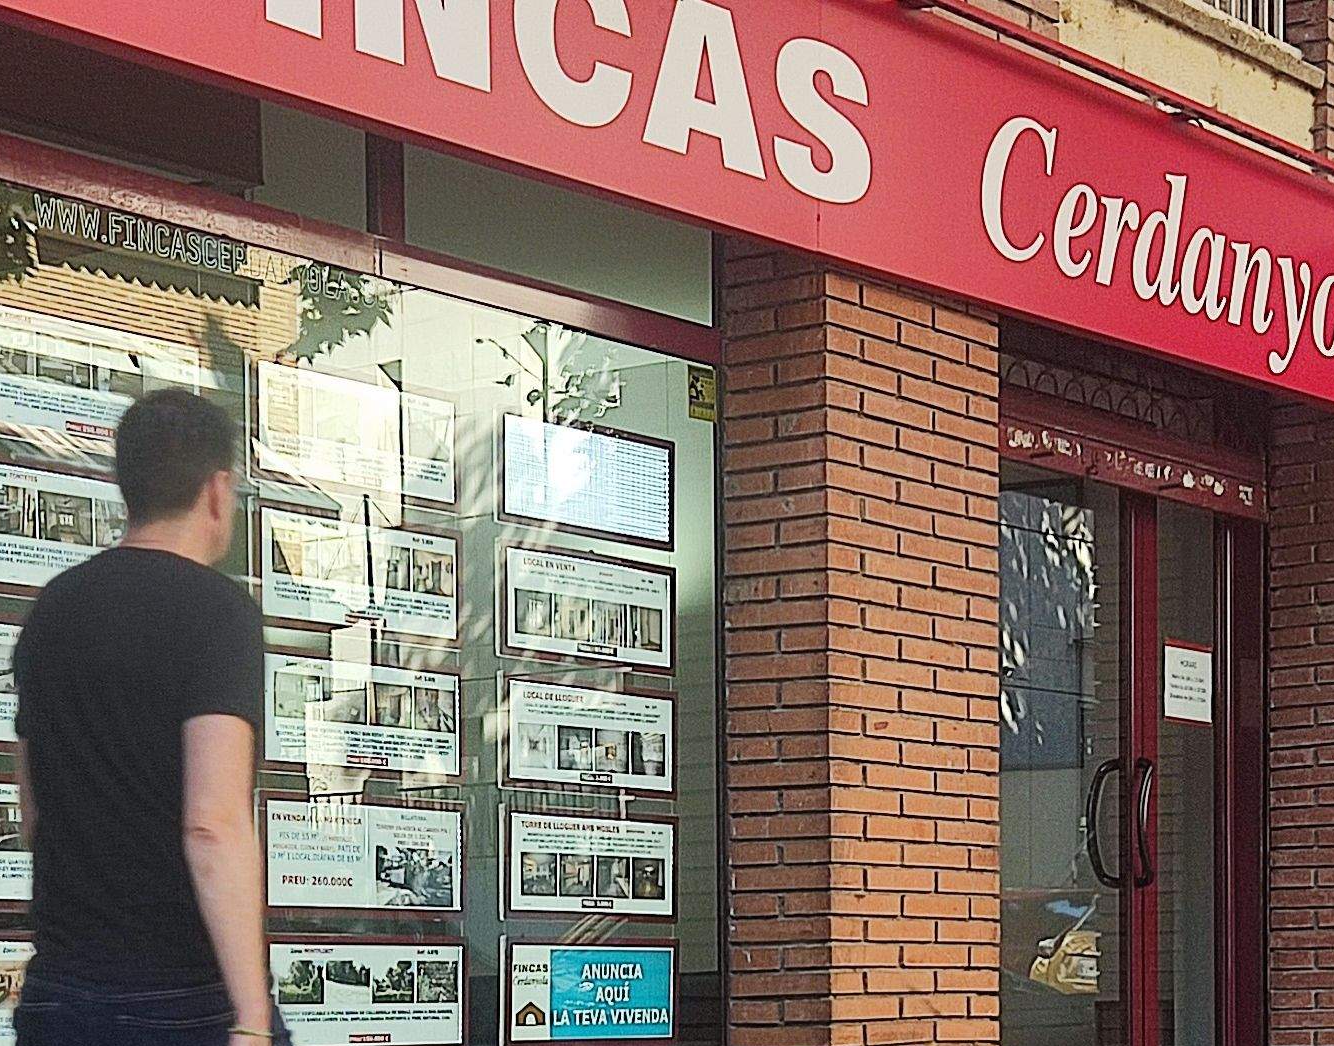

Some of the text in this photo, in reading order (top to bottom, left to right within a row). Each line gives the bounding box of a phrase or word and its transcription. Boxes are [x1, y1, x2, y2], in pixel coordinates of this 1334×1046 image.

[513, 964, 549, 973] FINCAS
[582, 964, 643, 980] ANUNCIA
[595, 981, 630, 1004] AQUÍ
[553, 1008, 669, 1026] LA TEVA VIVENDA
